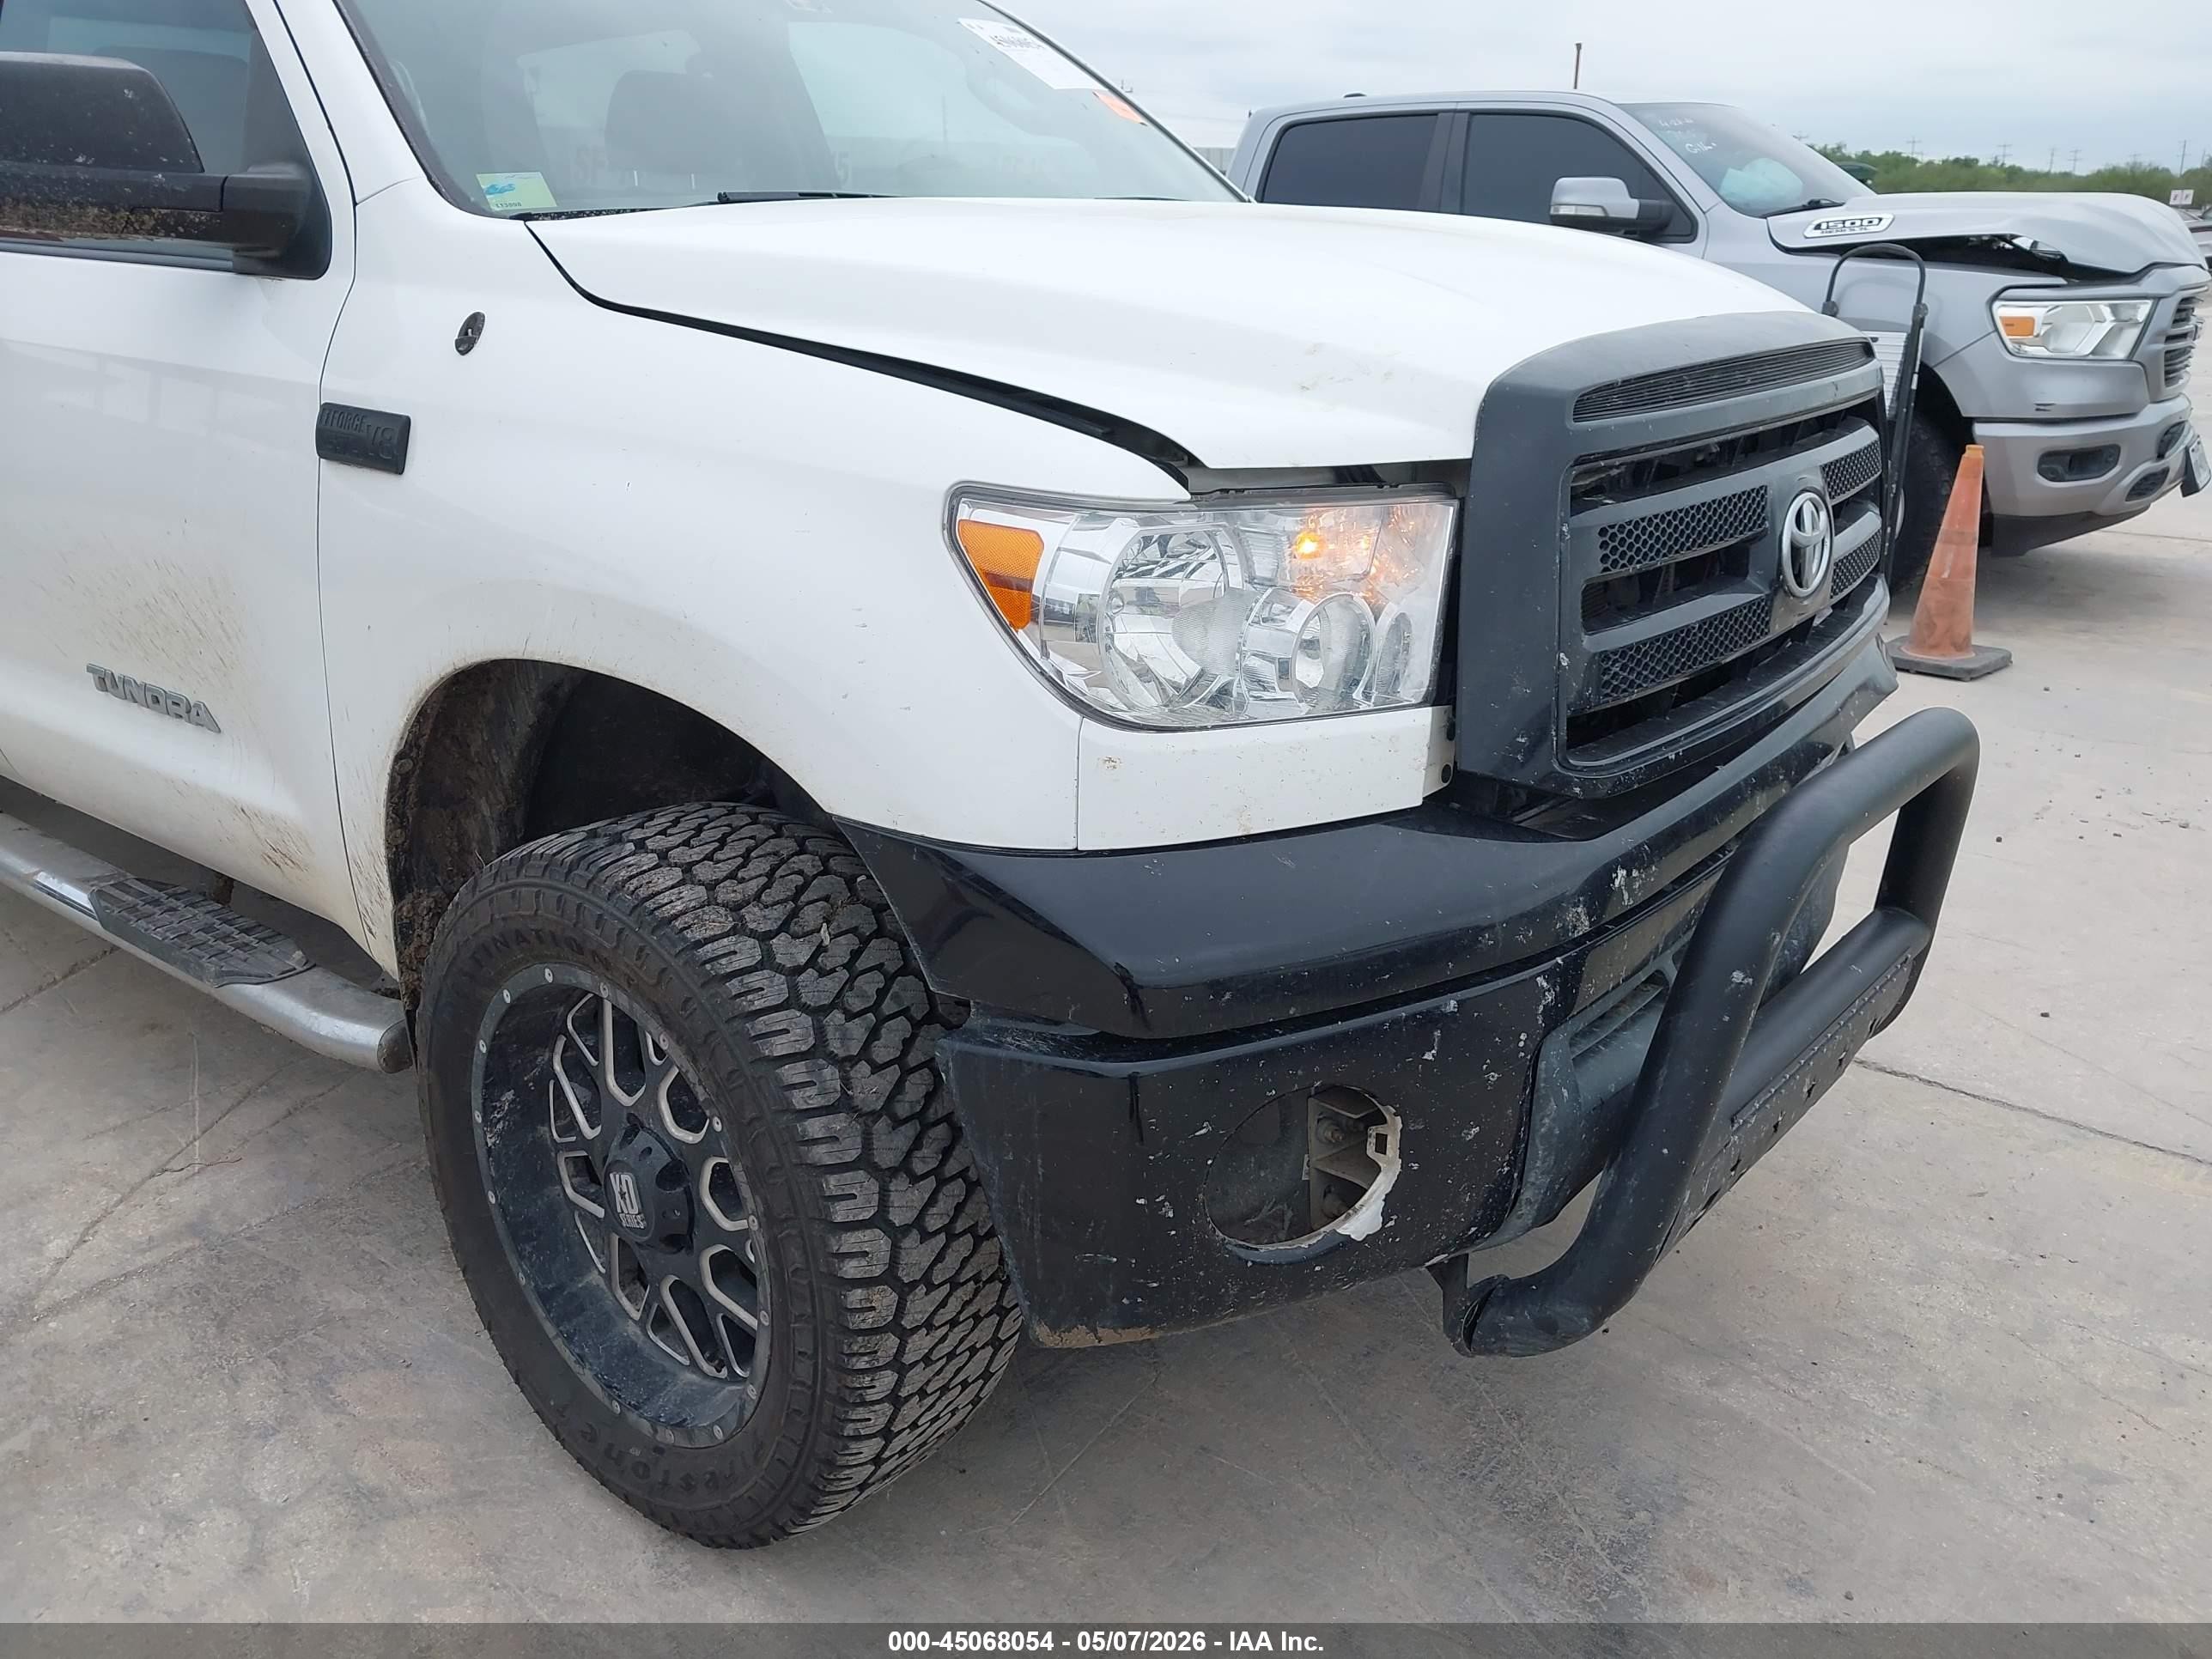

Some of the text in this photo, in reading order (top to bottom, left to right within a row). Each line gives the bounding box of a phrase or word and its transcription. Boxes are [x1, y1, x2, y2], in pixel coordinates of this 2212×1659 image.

[1820, 217, 1881, 230] 1500
[87, 663, 222, 733] TUNDRA
[609, 1171, 640, 1214] XD
[619, 1212, 646, 1230] SERIES
